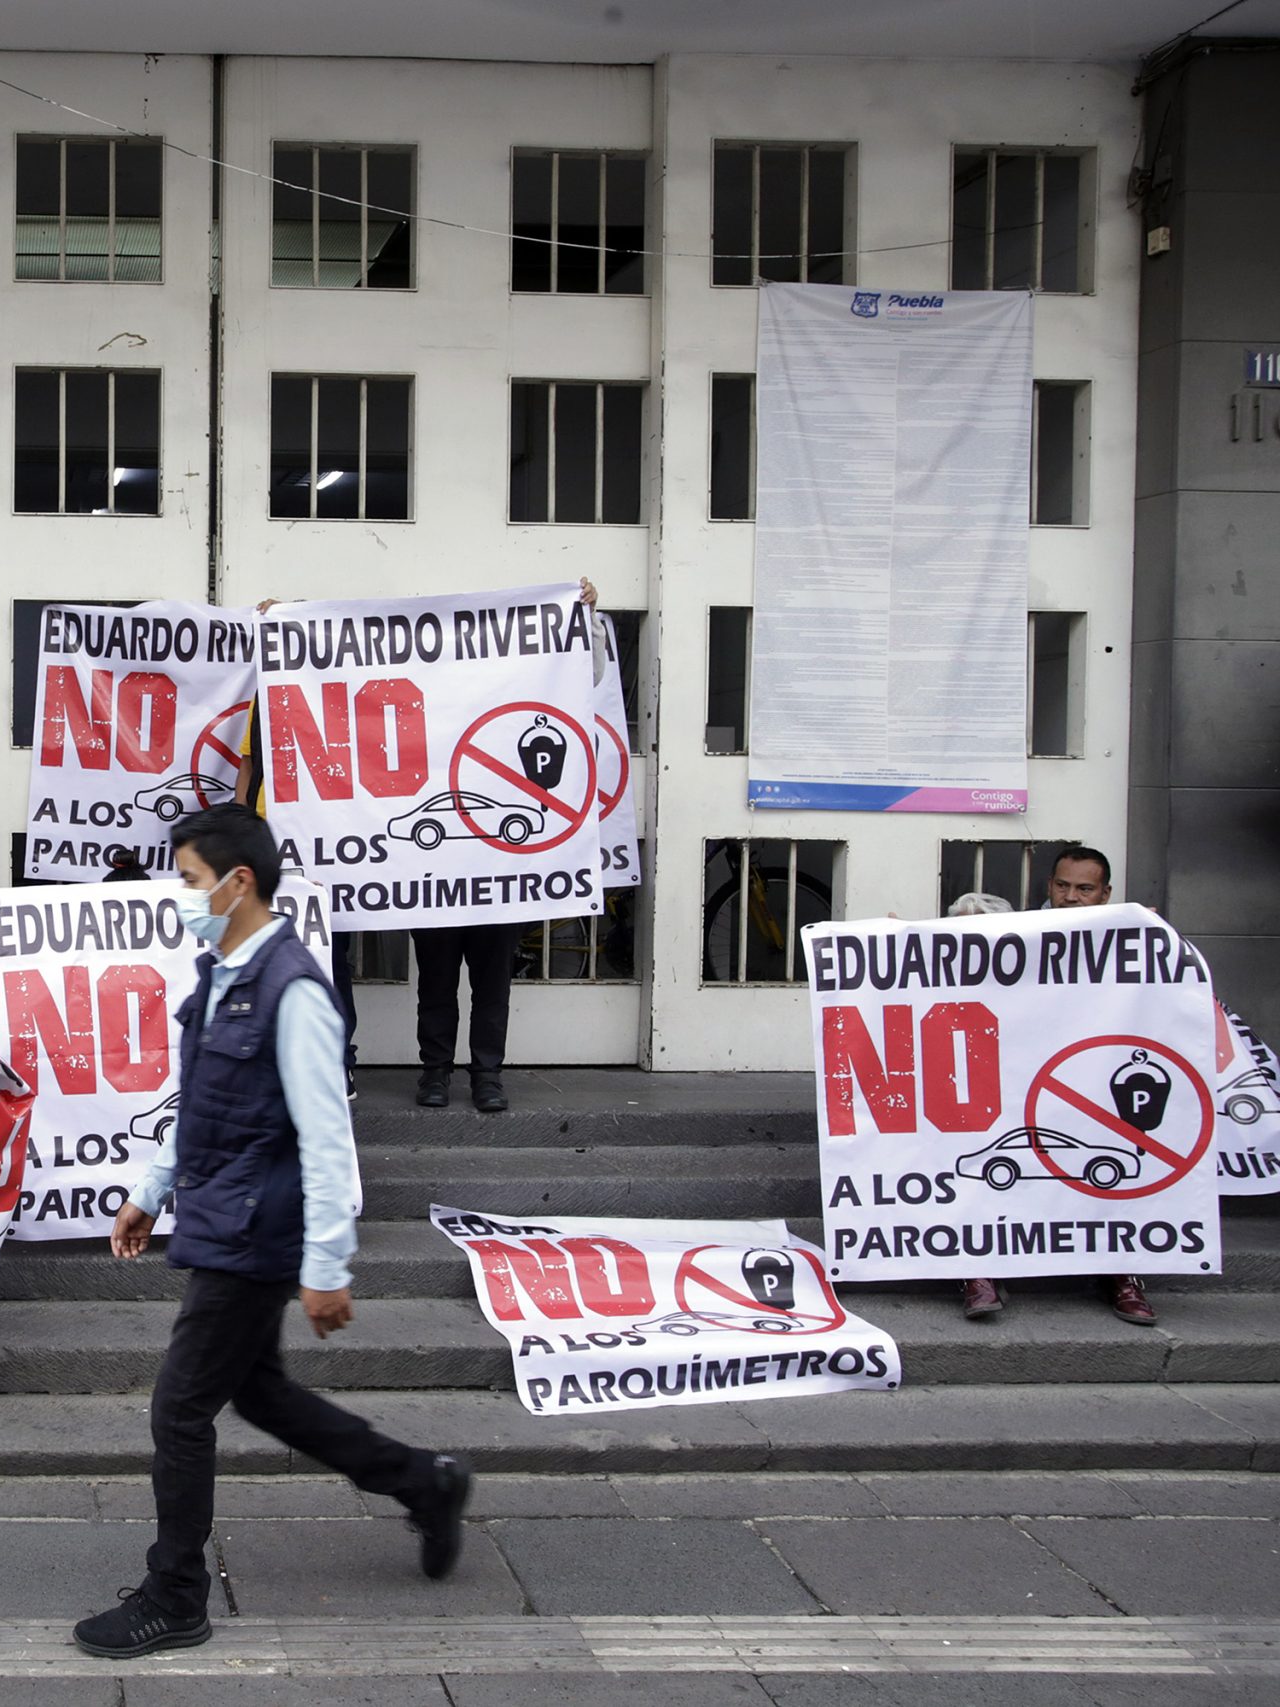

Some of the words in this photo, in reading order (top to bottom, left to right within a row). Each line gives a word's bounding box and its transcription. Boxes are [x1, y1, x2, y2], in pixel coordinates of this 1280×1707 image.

[888, 294, 945, 308] Puebla
[43, 610, 199, 663] EDUARDO
[207, 619, 255, 663] RIV
[261, 612, 443, 672] EDUARDO
[454, 601, 591, 661] RIVERA
[40, 665, 177, 774] NO
[267, 678, 429, 803] NO
[536, 752, 552, 774] P
[33, 798, 60, 824] A
[69, 800, 133, 829] LOS
[971, 790, 1014, 802] Contigo
[279, 838, 303, 867] A
[314, 834, 389, 866] LOS
[332, 867, 594, 913] RQUÍMETROS
[811, 931, 1027, 992] EDUARDO
[1038, 927, 1208, 986] RIVERA
[3, 965, 170, 1096] NO
[821, 1002, 1002, 1137] NO
[1132, 1090, 1151, 1114] P
[53, 1132, 130, 1168] LOS
[829, 1175, 863, 1208] A
[872, 1171, 958, 1206] LOS
[834, 1215, 1206, 1260] PARQUÍMETROS
[464, 1237, 657, 1321] NO
[762, 1274, 780, 1298] P
[519, 1333, 544, 1357] A
[559, 1330, 648, 1352] LOS
[526, 1344, 888, 1409] PARQUÍMETROS
